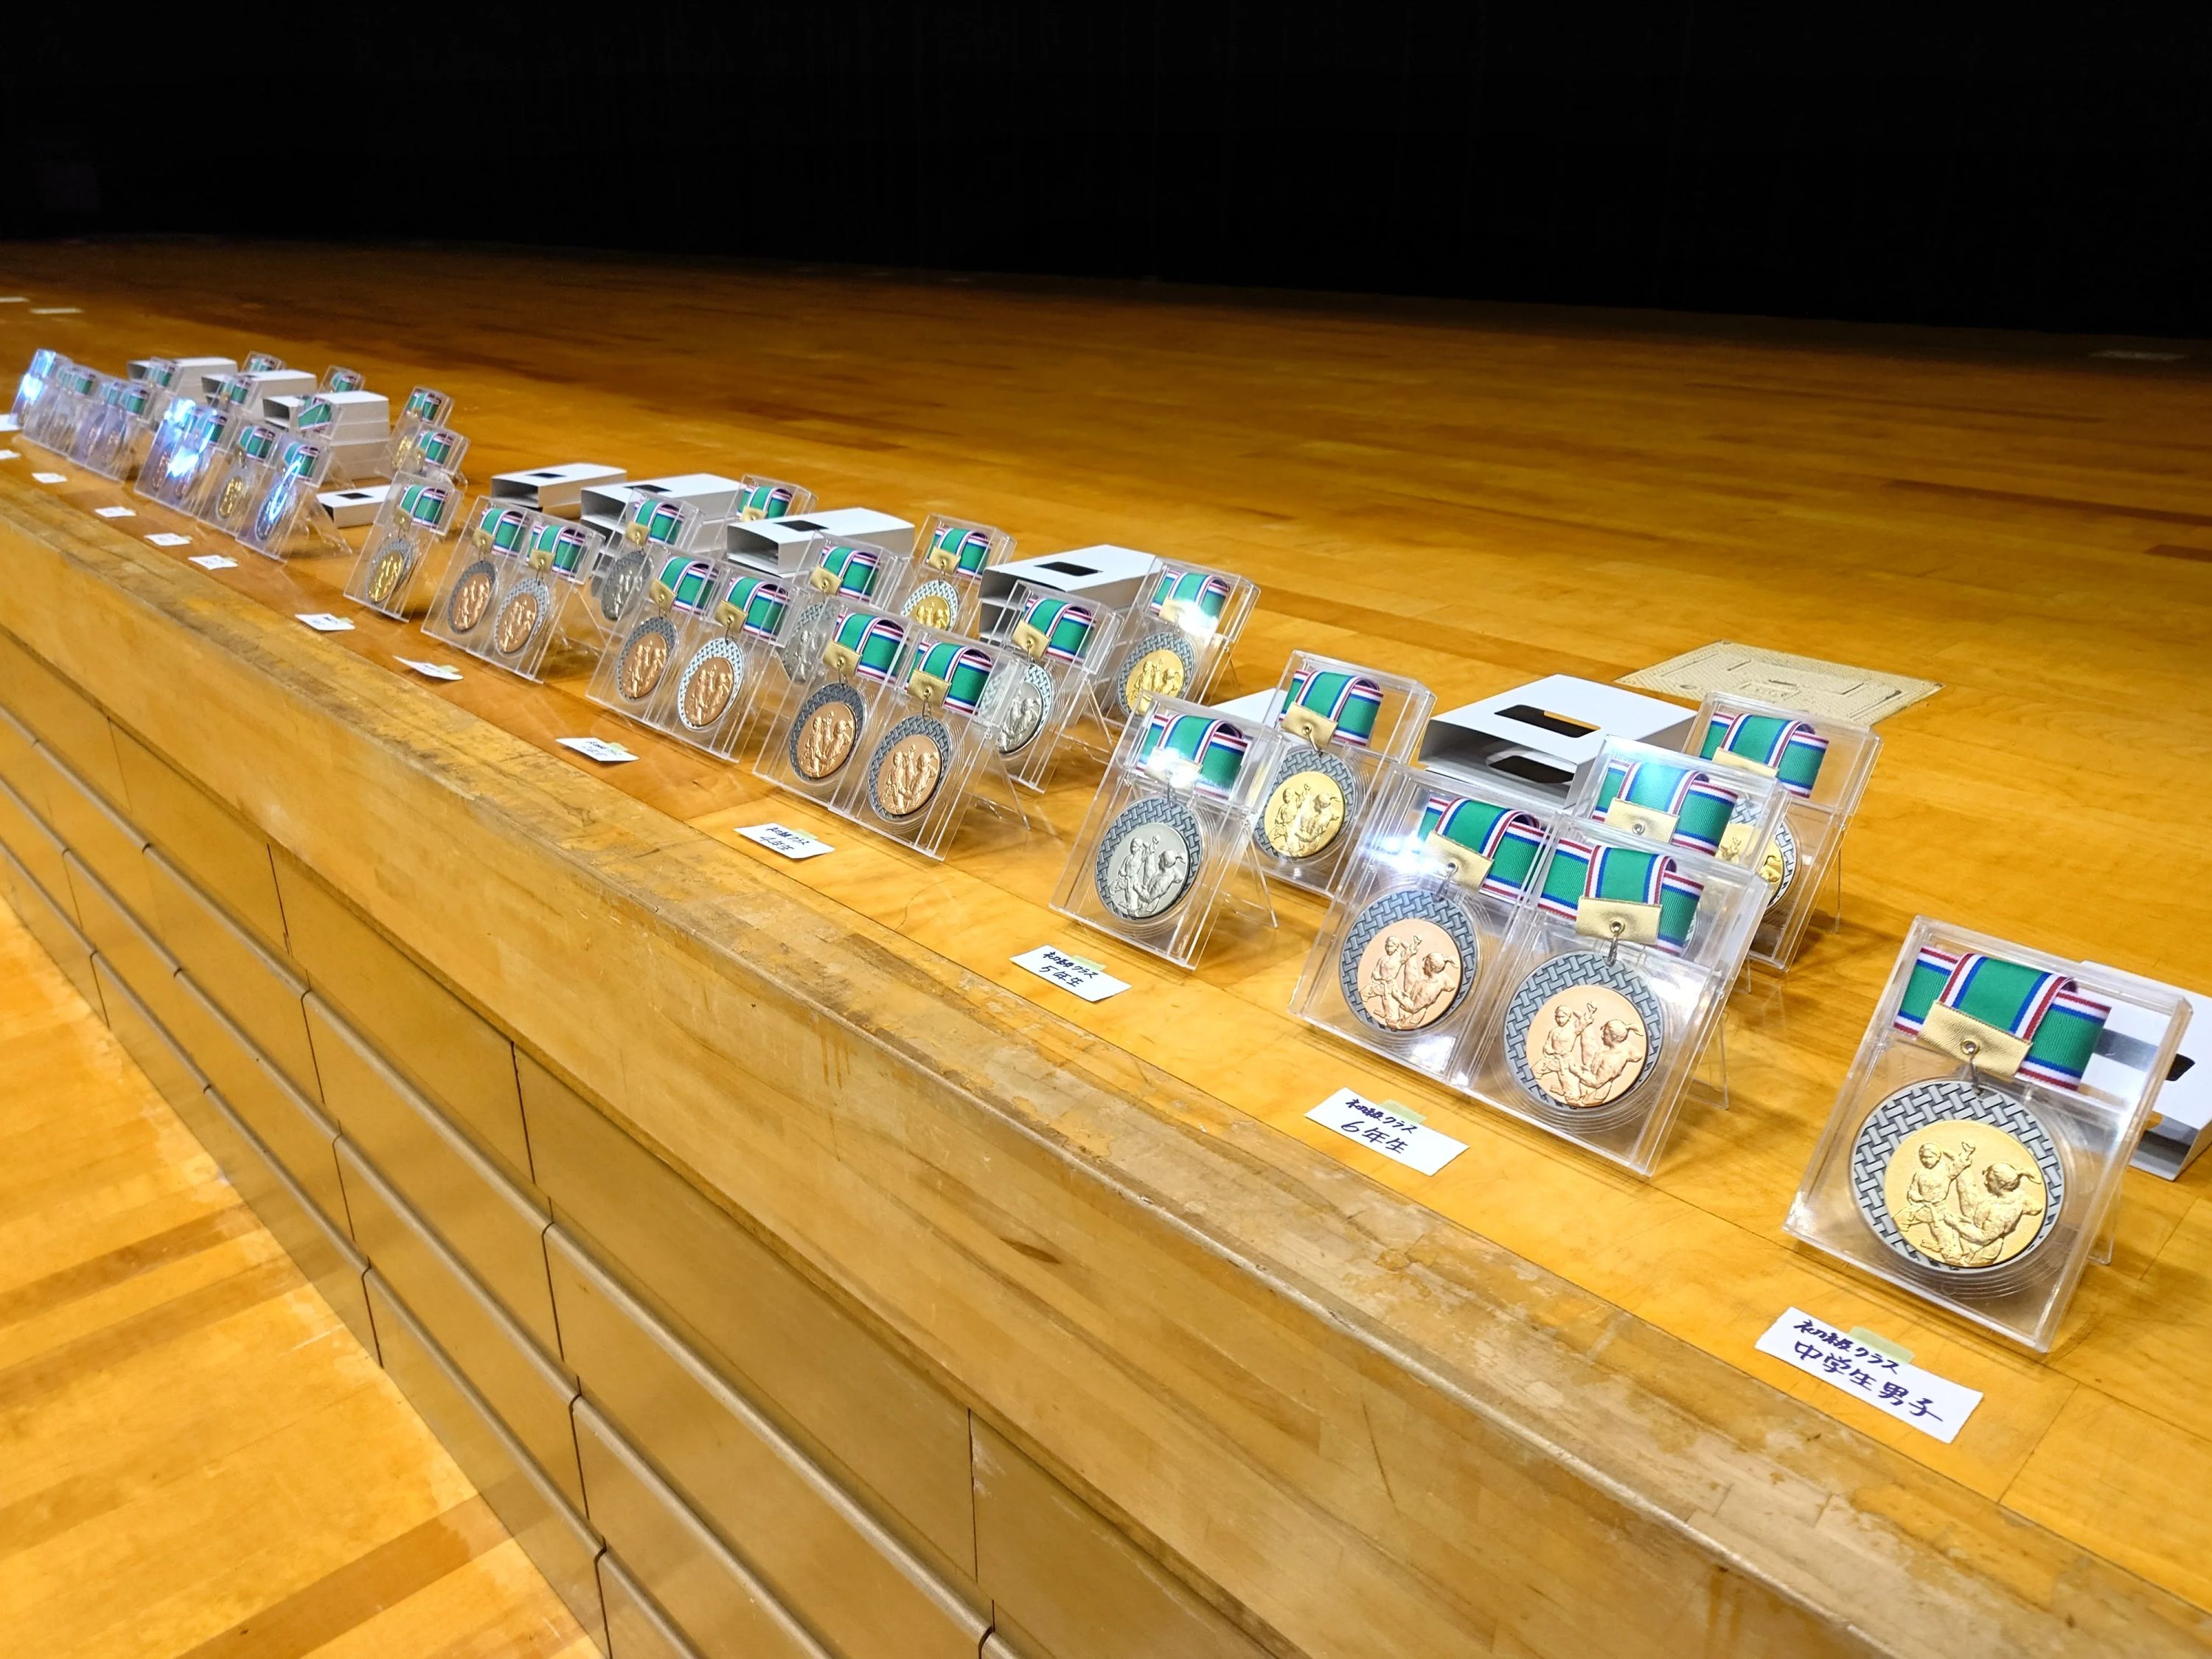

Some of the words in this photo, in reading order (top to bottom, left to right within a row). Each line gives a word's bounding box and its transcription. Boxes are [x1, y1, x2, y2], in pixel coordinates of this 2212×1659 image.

[1039, 965, 1084, 987] 5年生
[1340, 1121, 1408, 1155] 6年生
[1793, 1319, 1899, 1374] 初級クラス
[1794, 1340, 1944, 1422] 中学生男子
